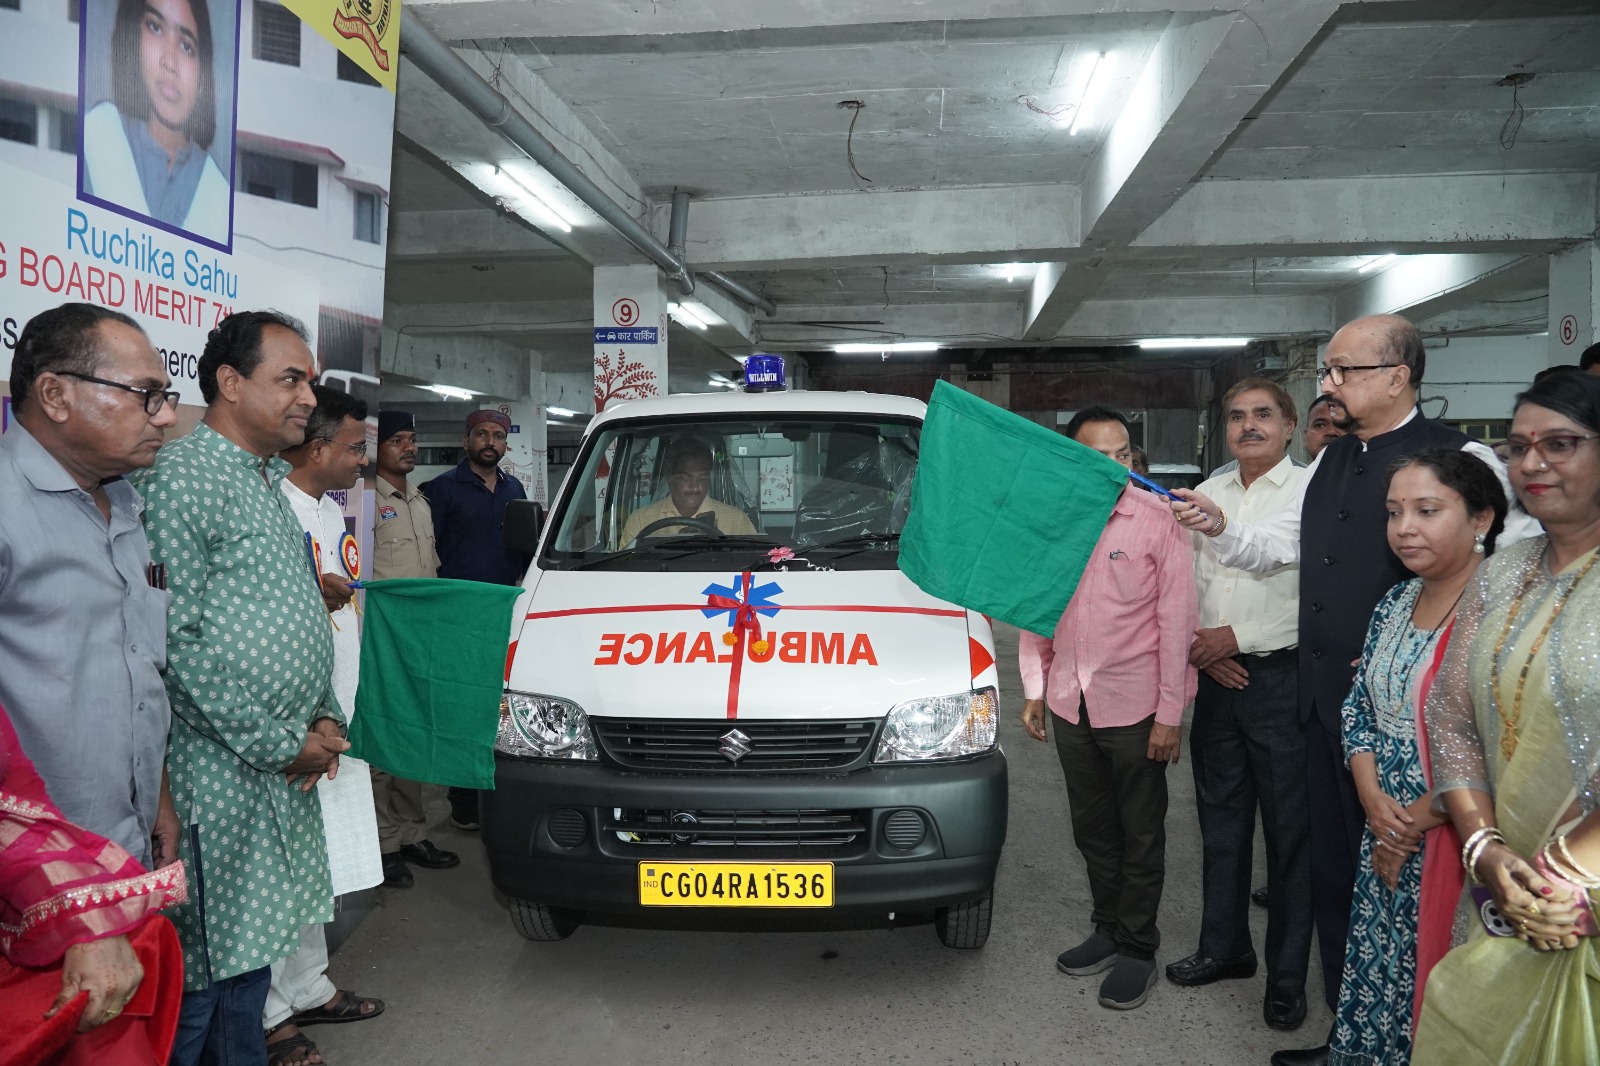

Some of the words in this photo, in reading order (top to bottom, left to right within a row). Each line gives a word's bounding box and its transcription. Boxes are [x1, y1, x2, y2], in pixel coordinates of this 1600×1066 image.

[67, 207, 175, 281] Ruchika
[184, 249, 238, 299] Sahu
[20, 246, 125, 307] BOARD
[134, 279, 206, 328] MERIT
[620, 304, 632, 323] 9
[617, 332, 632, 341] कार
[1563, 320, 1572, 340] 6
[643, 880, 659, 888] IND
[660, 872, 825, 899] CG04RA1536
